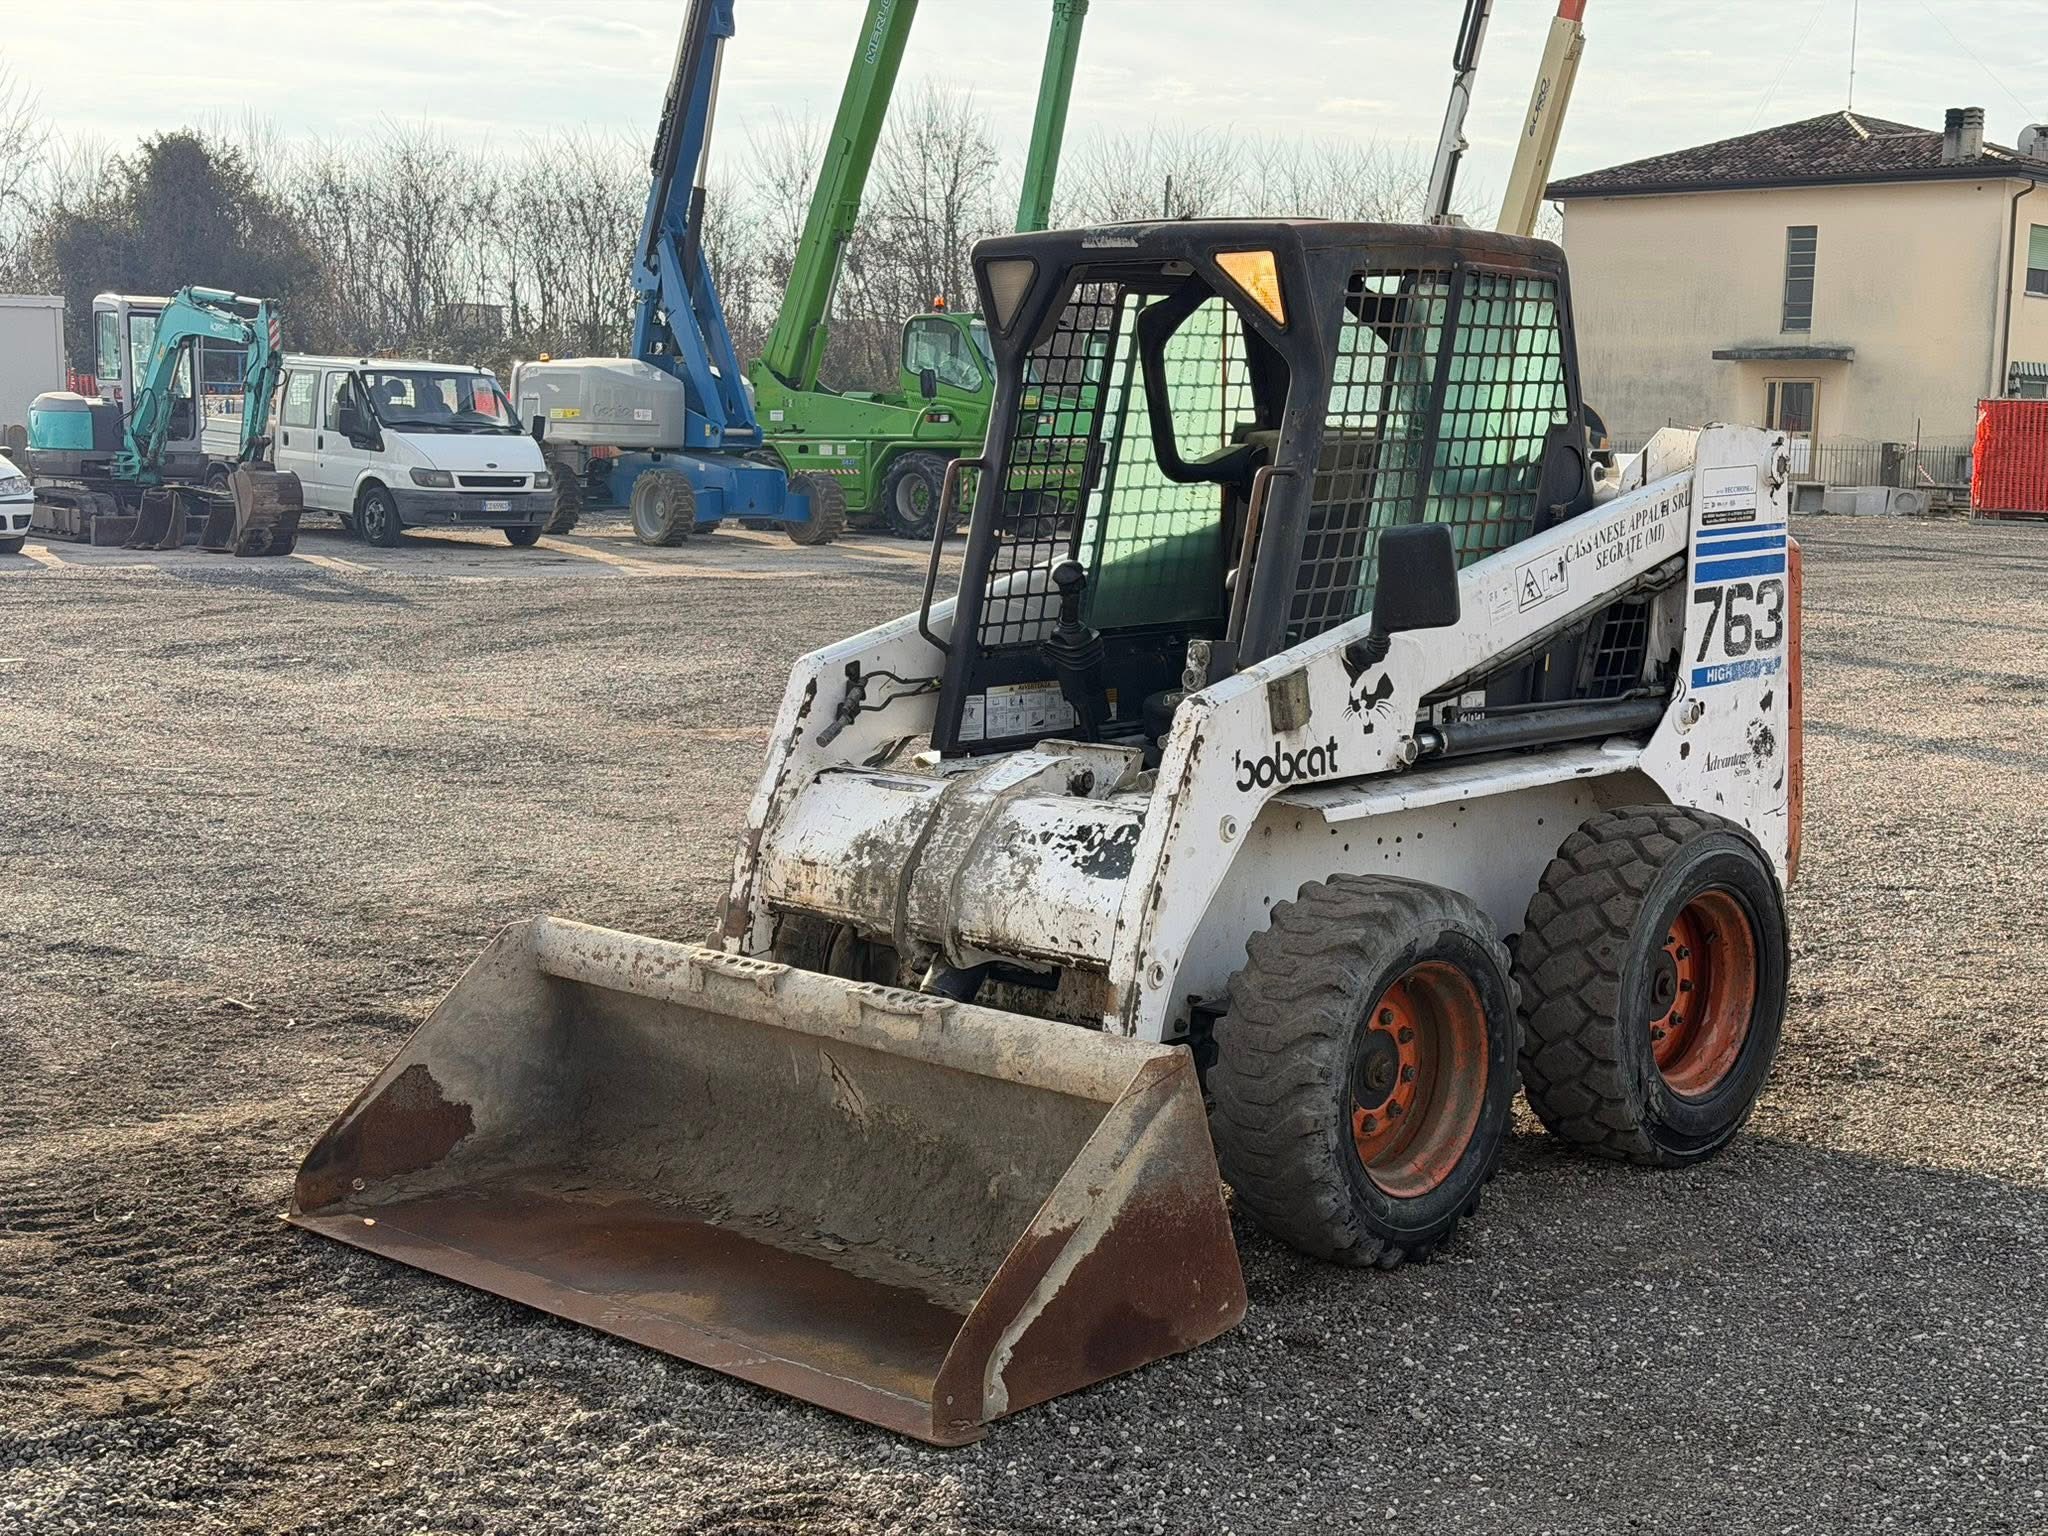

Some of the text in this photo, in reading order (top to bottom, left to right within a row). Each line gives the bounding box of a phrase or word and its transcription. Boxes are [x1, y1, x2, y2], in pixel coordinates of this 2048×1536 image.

[1672, 489, 1690, 513] SRL
[1595, 532, 1643, 571] SEGRATE
[1693, 578, 1784, 663] 763
[1706, 667, 1733, 683] HIGH
[1235, 735, 1338, 793] bobcat
